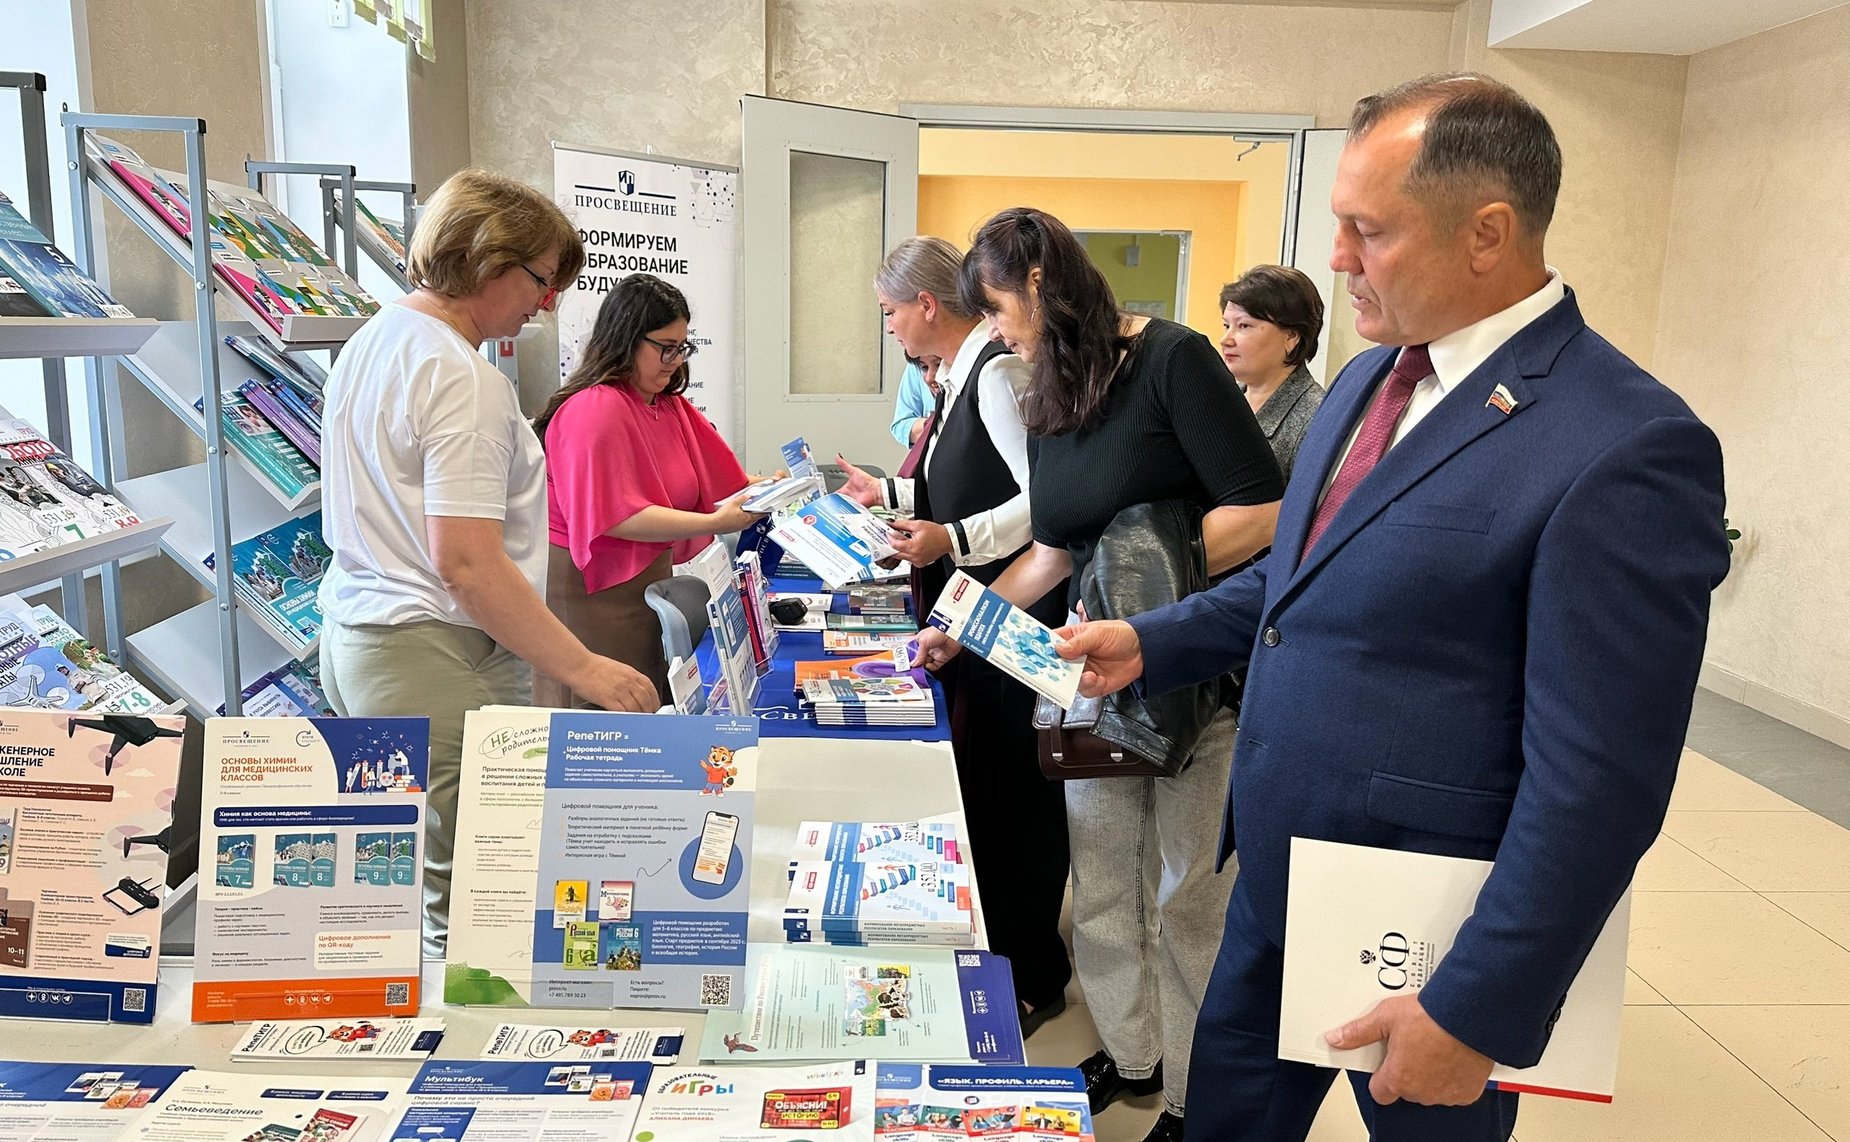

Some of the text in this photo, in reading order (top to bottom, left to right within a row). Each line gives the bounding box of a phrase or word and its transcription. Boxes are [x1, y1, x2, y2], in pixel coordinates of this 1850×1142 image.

[575, 194, 677, 217] ПРОСВЕЩЕНИЕ
[588, 253, 688, 274] БРАЗОВАНИЕ
[64, 524, 86, 539] 7
[491, 726, 549, 747] НЕ сложно
[568, 731, 621, 741] РепеТИГР
[566, 746, 601, 754] Цифровой
[0, 757, 43, 767] ШЛЕНИЕ
[566, 754, 594, 762] Рабочая
[0, 768, 26, 776] КОЛЕ
[221, 765, 313, 774] ДЛЯ МЕДИЦИНСКИХ
[235, 875, 241, 884] 7
[292, 873, 298, 881] 8
[316, 873, 323, 881] 8
[373, 872, 379, 880] 9
[397, 871, 403, 879] 9
[634, 928, 639, 938] 6
[566, 949, 573, 963] 6
[1377, 931, 1410, 991] СФ
[1410, 941, 1418, 988] СОВЕТ
[1417, 941, 1425, 988] ФЕДЕРАЦИИ
[242, 1022, 272, 1052] РепеТИГР
[488, 1026, 510, 1055] РепеТИГР
[425, 1076, 484, 1084] Мультибук
[165, 1104, 263, 1115] Семьеведение
[775, 1101, 827, 1109] ОБЪЯСНИ!
